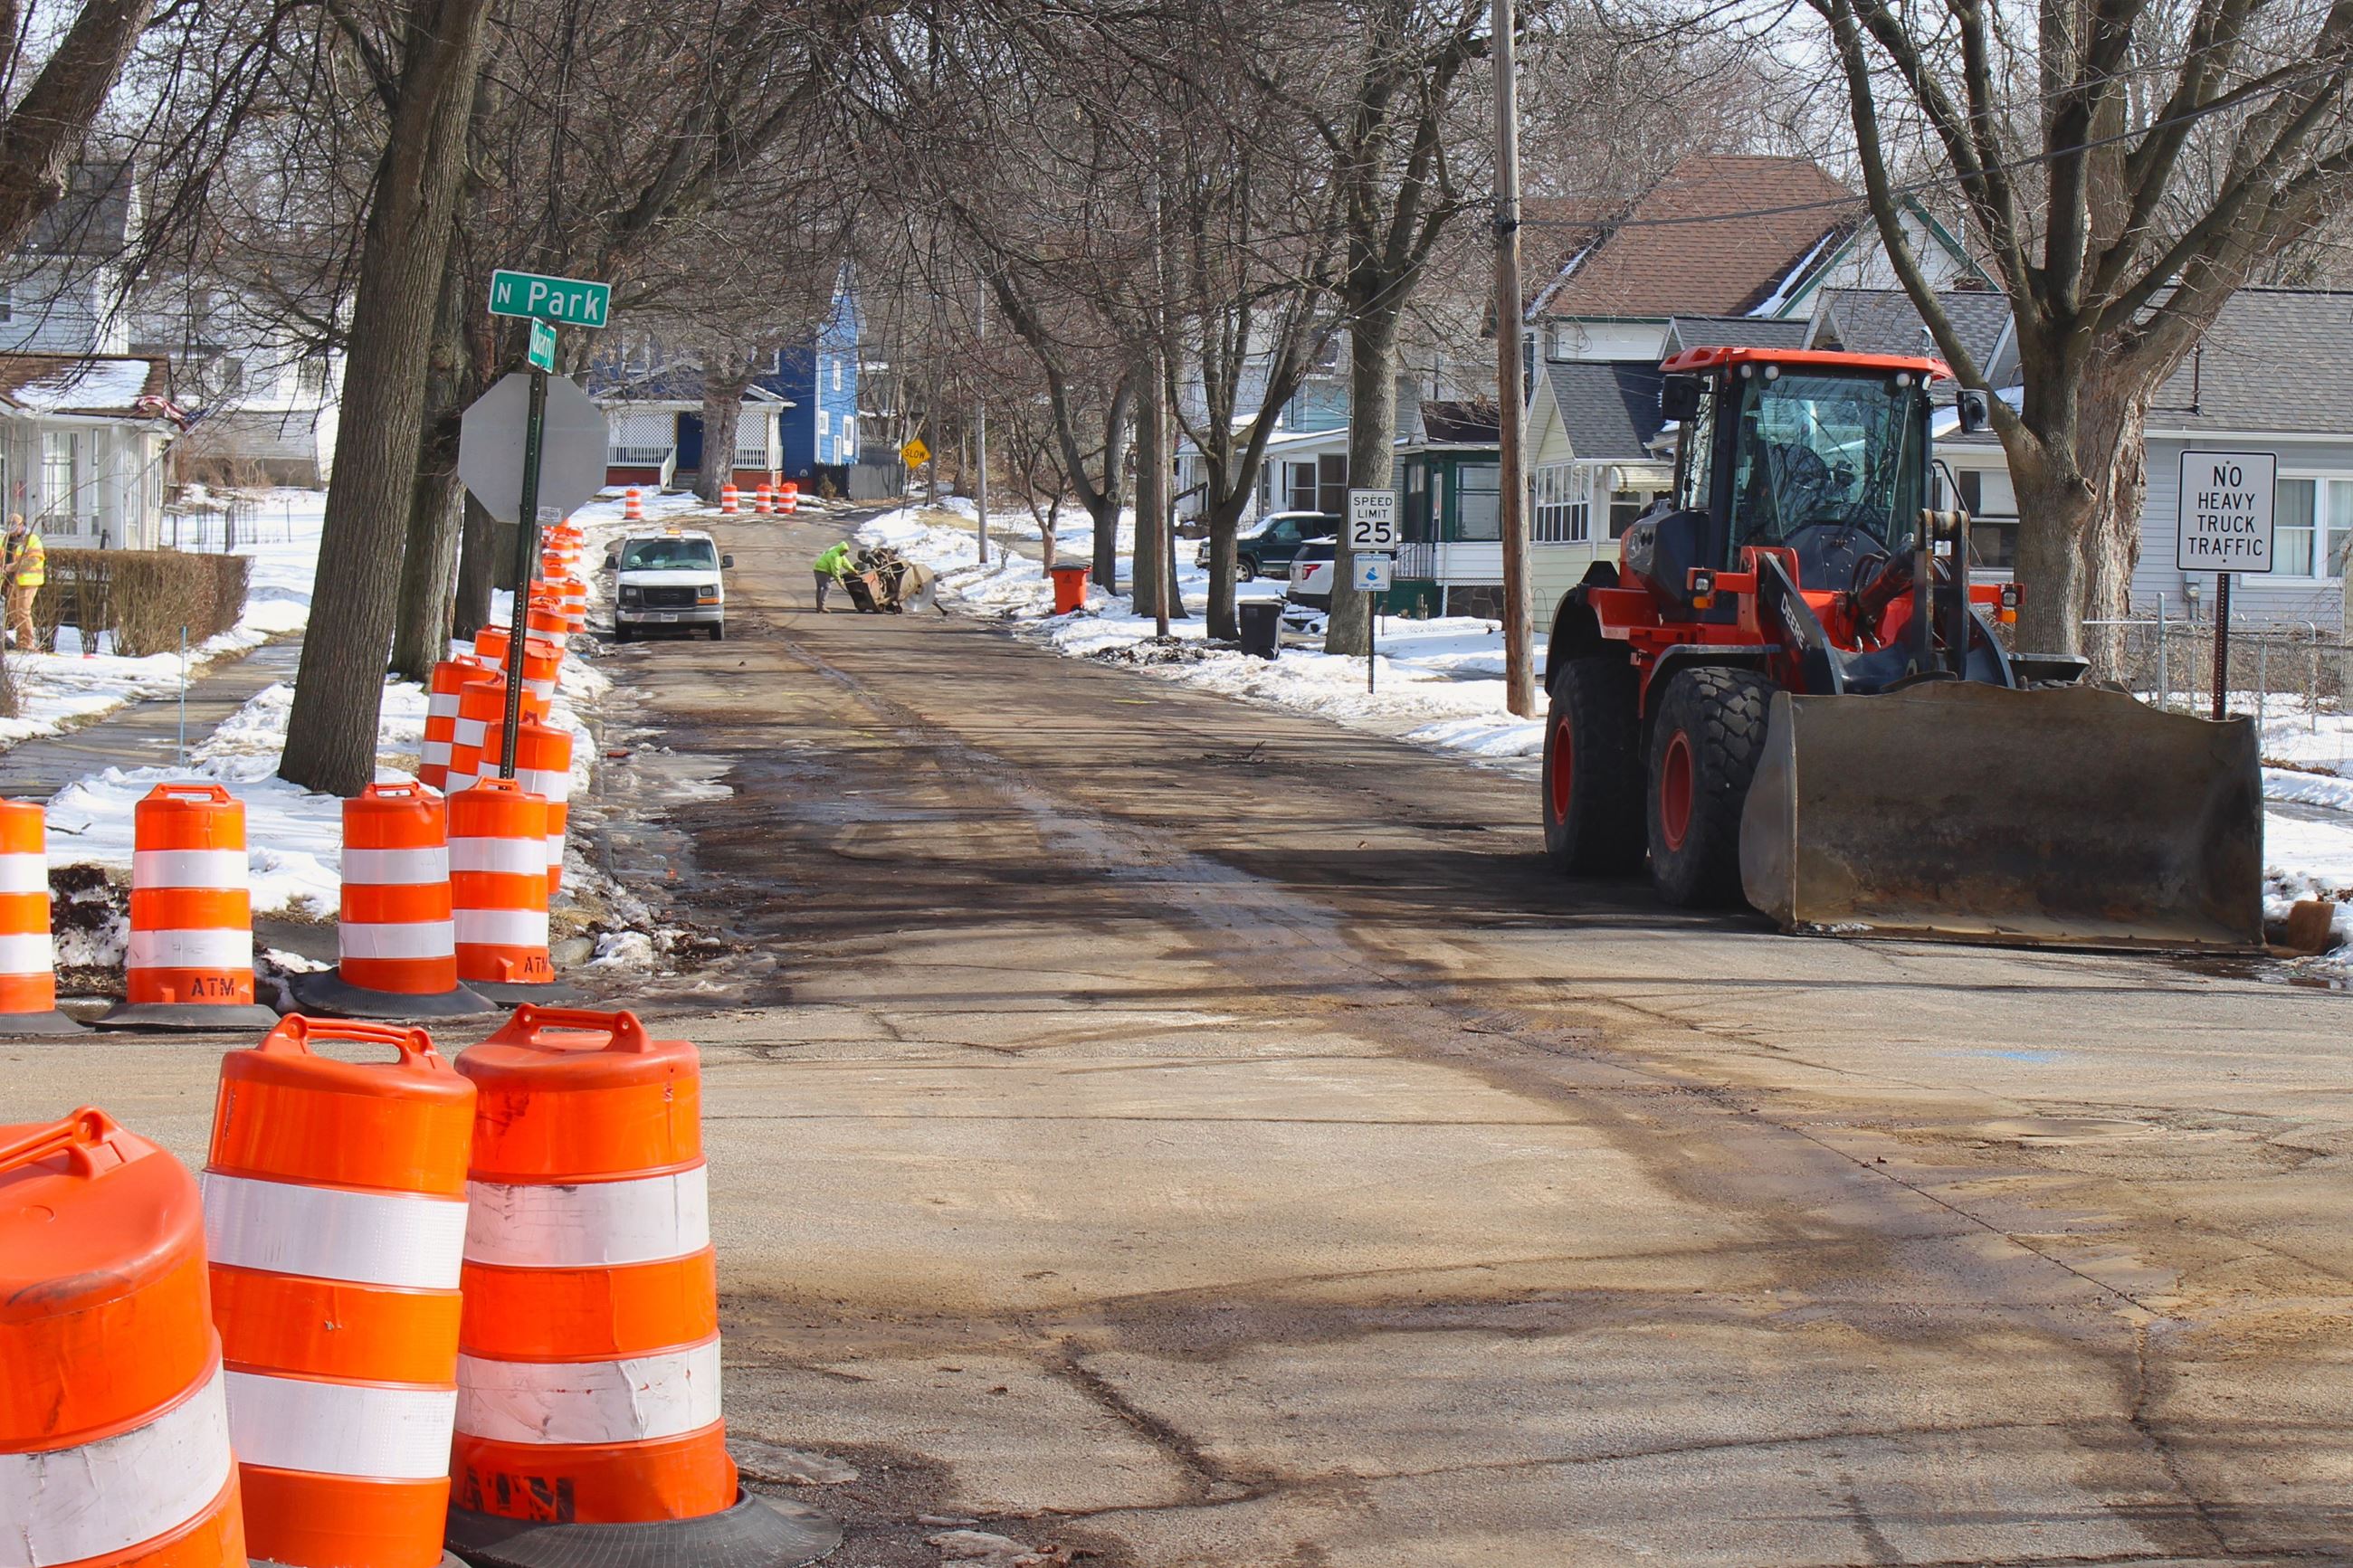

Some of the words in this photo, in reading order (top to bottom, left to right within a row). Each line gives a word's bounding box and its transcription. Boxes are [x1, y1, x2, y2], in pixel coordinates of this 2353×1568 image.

[498, 282, 512, 304] N
[527, 281, 601, 320] Park
[905, 448, 926, 459] SLOW
[2213, 466, 2243, 487] NO
[1353, 497, 1393, 507] SPEED
[2197, 492, 2255, 510] HEAVY
[1358, 509, 1388, 518] LIMIT
[1354, 521, 1391, 544] 25
[2197, 515, 2255, 533] TRUCK
[2187, 537, 2263, 556] TRAFFIC
[1780, 592, 1805, 651] DEERE
[191, 977, 234, 996] ATM
